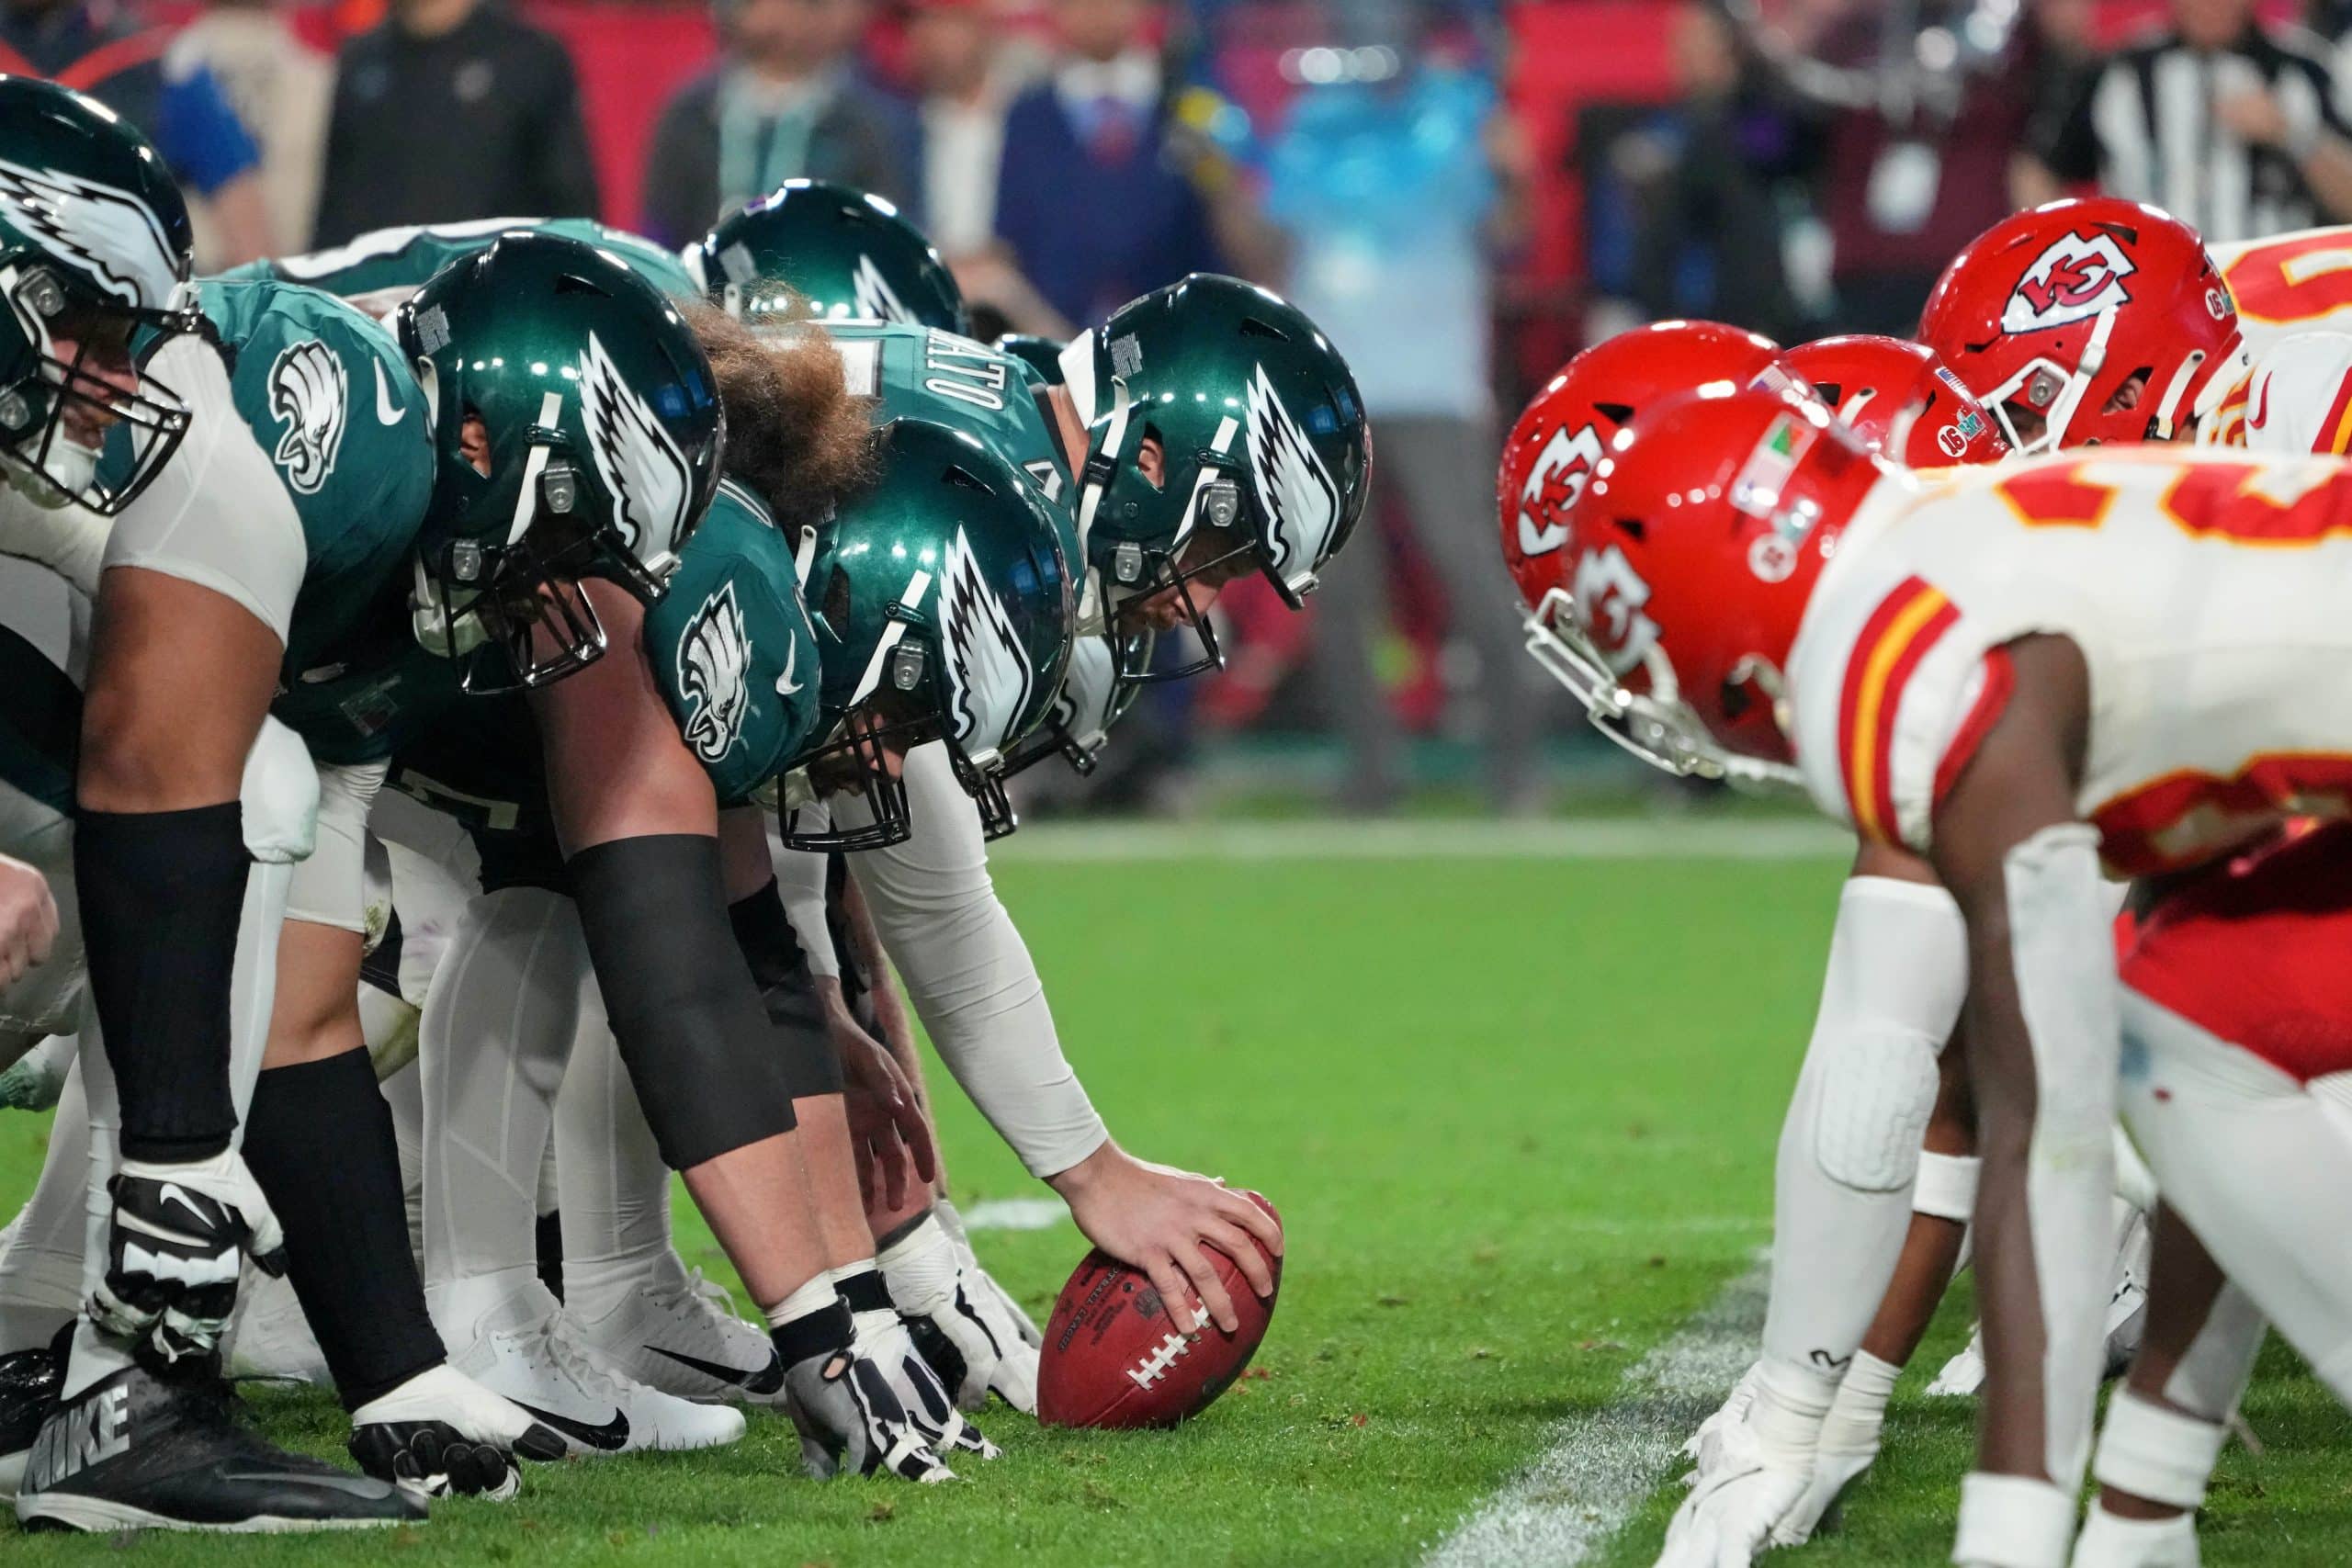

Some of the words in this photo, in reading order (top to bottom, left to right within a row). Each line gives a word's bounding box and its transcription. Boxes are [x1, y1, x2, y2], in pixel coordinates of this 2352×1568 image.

[2018, 252, 2117, 317] KC
[1940, 427, 1966, 456] 16
[21, 1382, 130, 1495] NIKE
